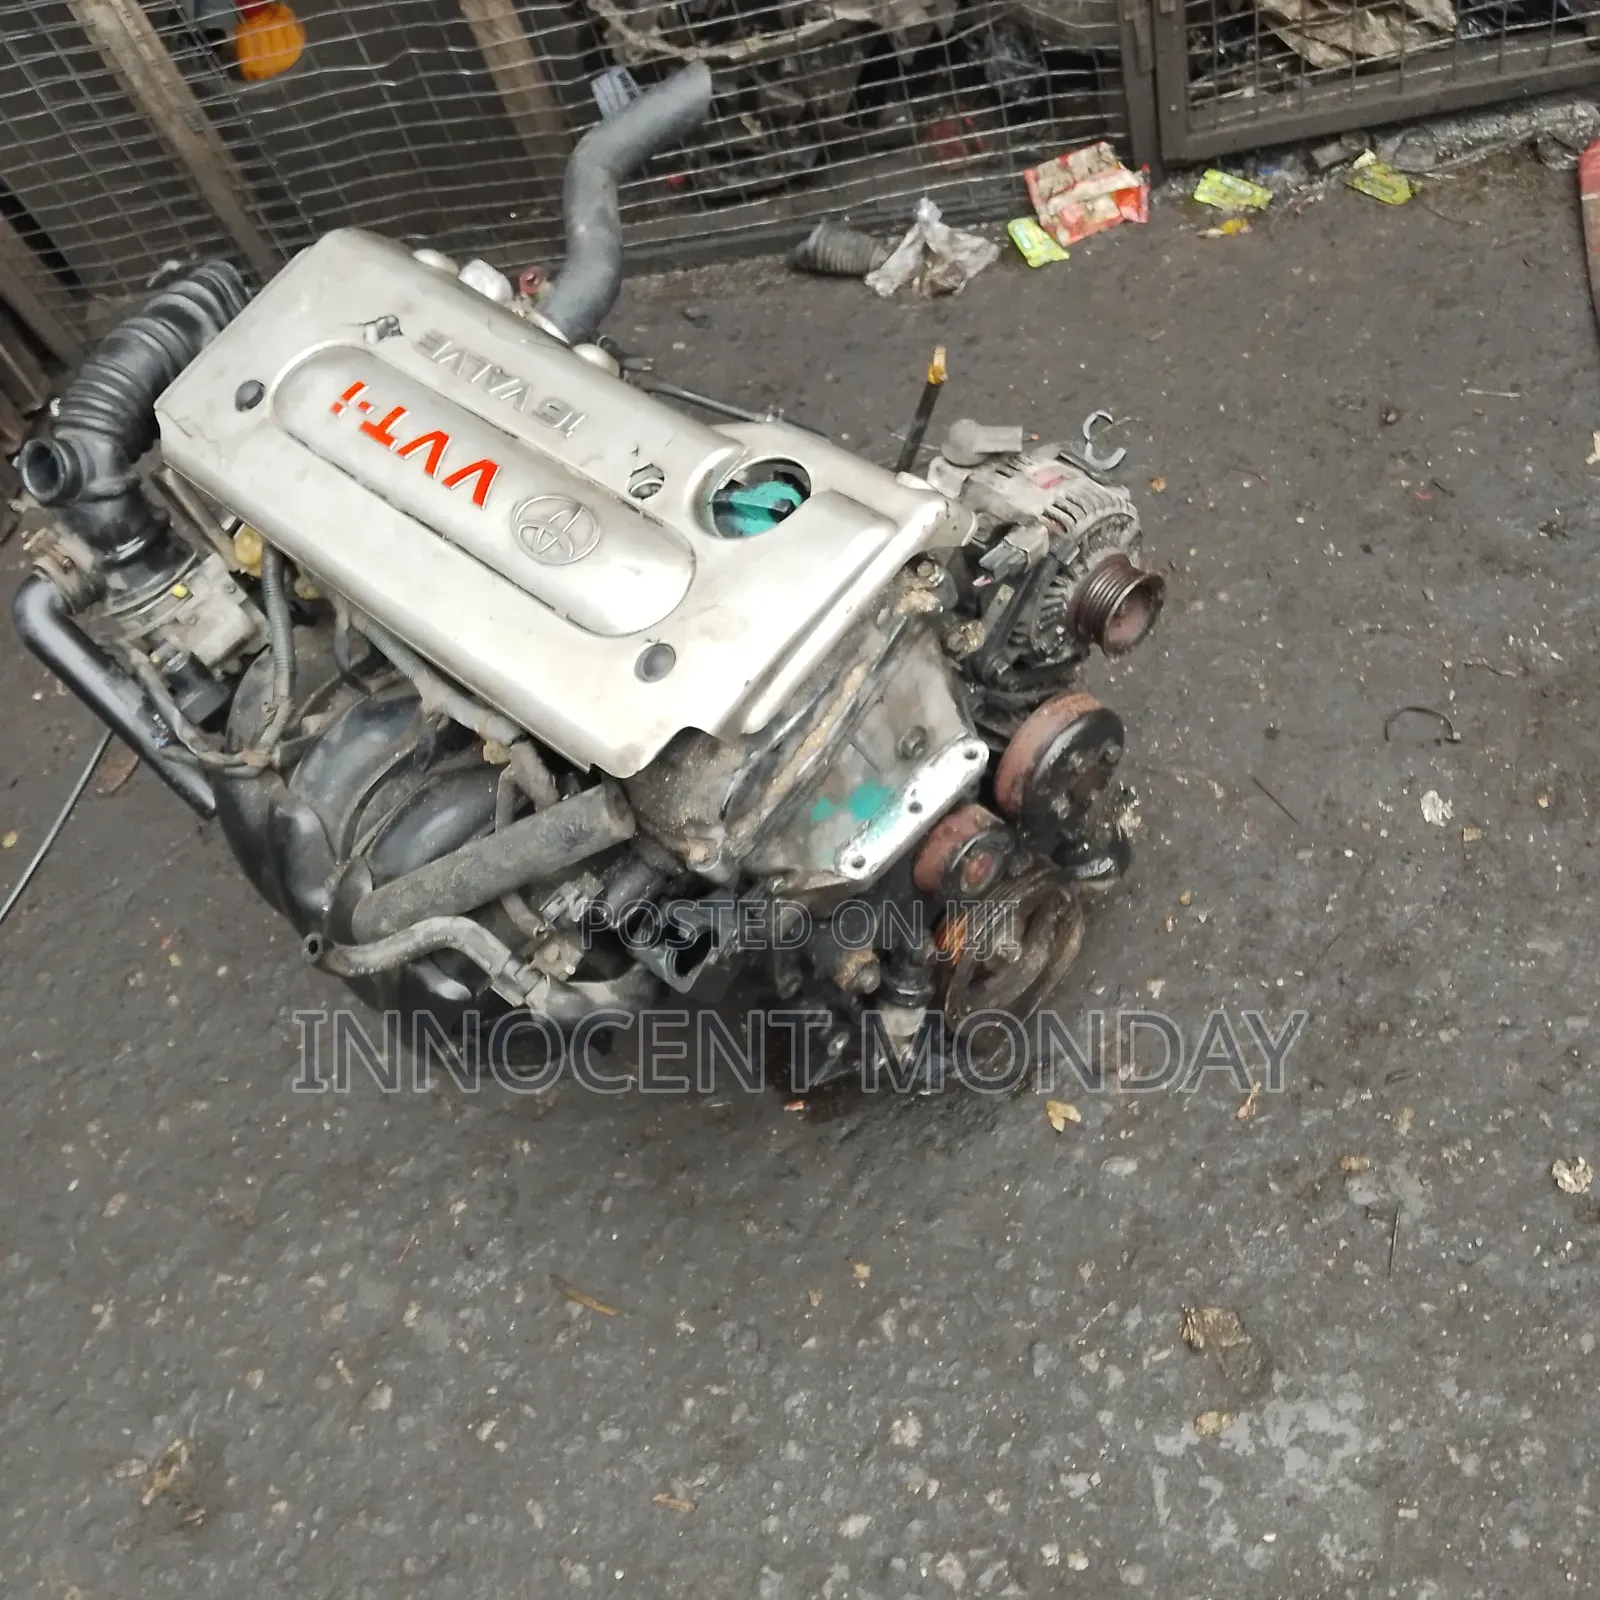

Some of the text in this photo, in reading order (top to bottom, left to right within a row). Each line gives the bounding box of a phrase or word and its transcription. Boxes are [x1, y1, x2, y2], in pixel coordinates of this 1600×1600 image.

[413, 328, 586, 438] 16 VALVE
[330, 380, 500, 510] VVT-i
